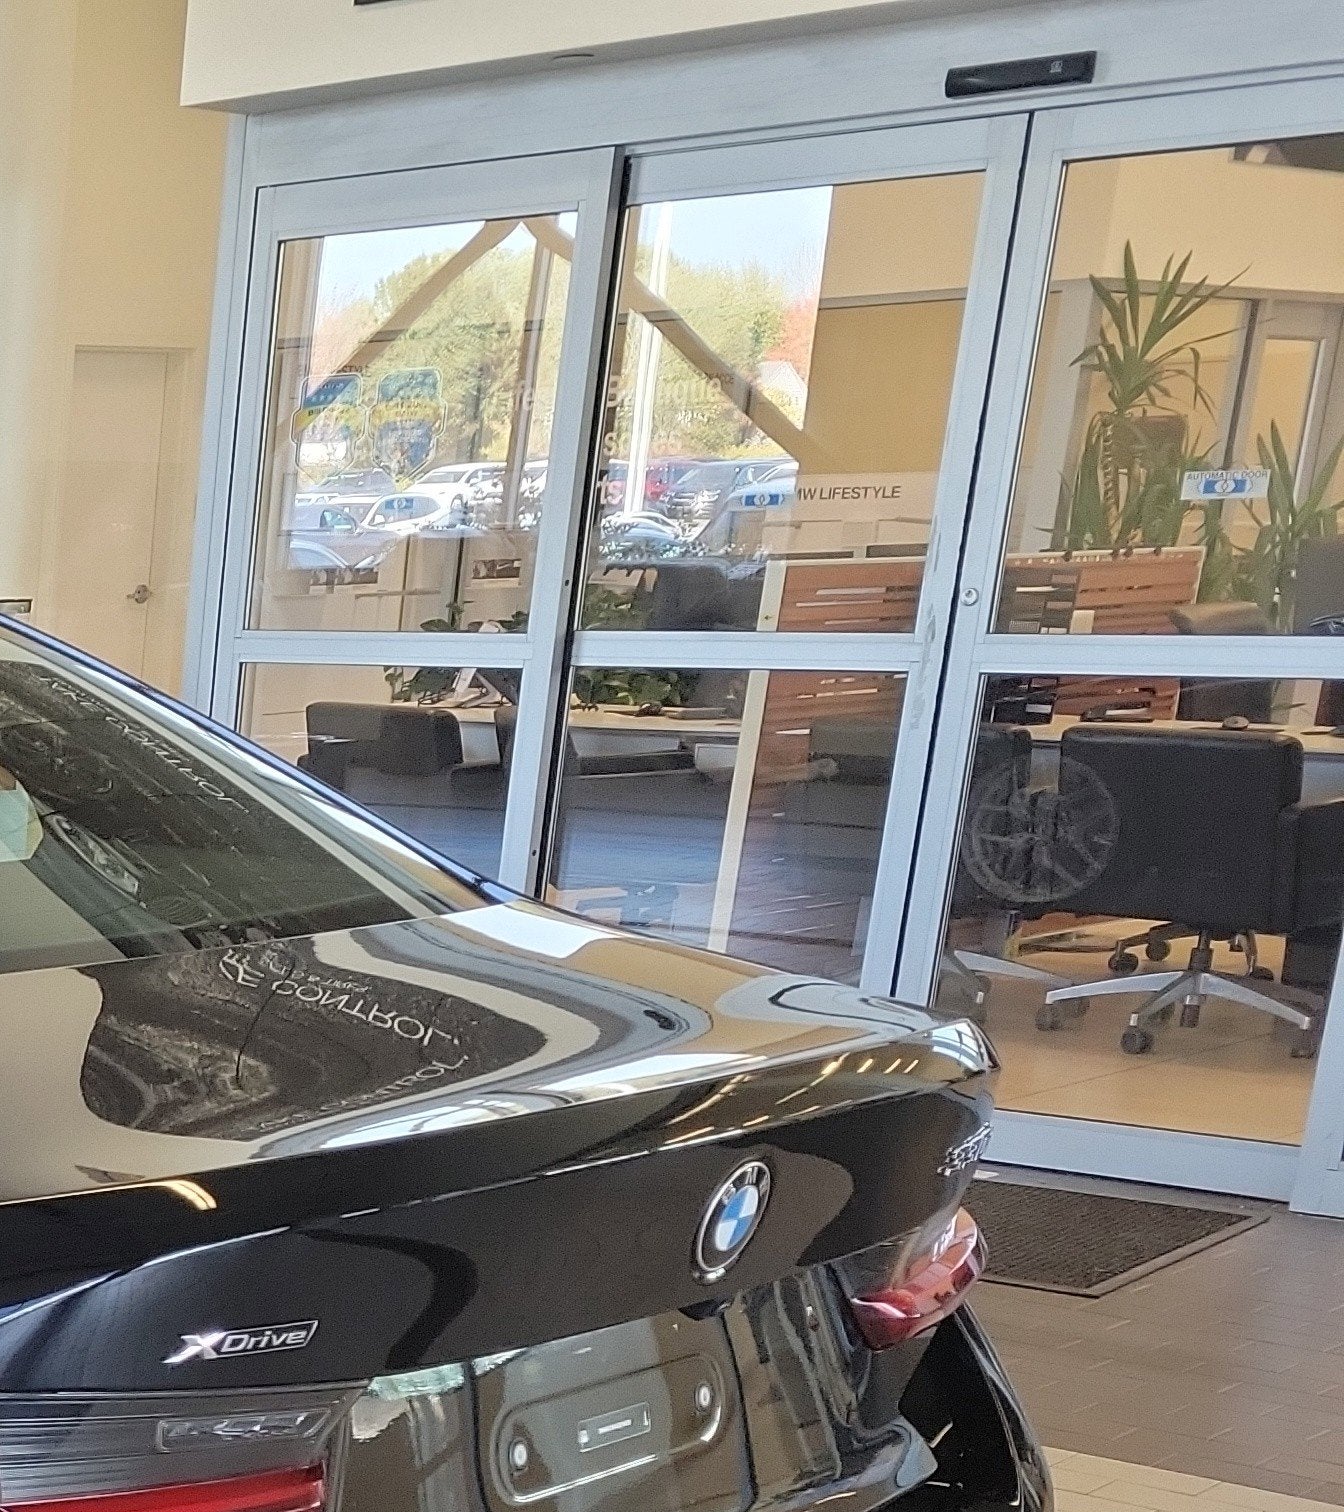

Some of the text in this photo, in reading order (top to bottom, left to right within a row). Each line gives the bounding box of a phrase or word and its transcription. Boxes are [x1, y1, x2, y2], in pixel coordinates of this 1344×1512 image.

[1186, 469, 1268, 481] AUTOMATIC DOOR
[819, 485, 902, 500] LIFESTYLE
